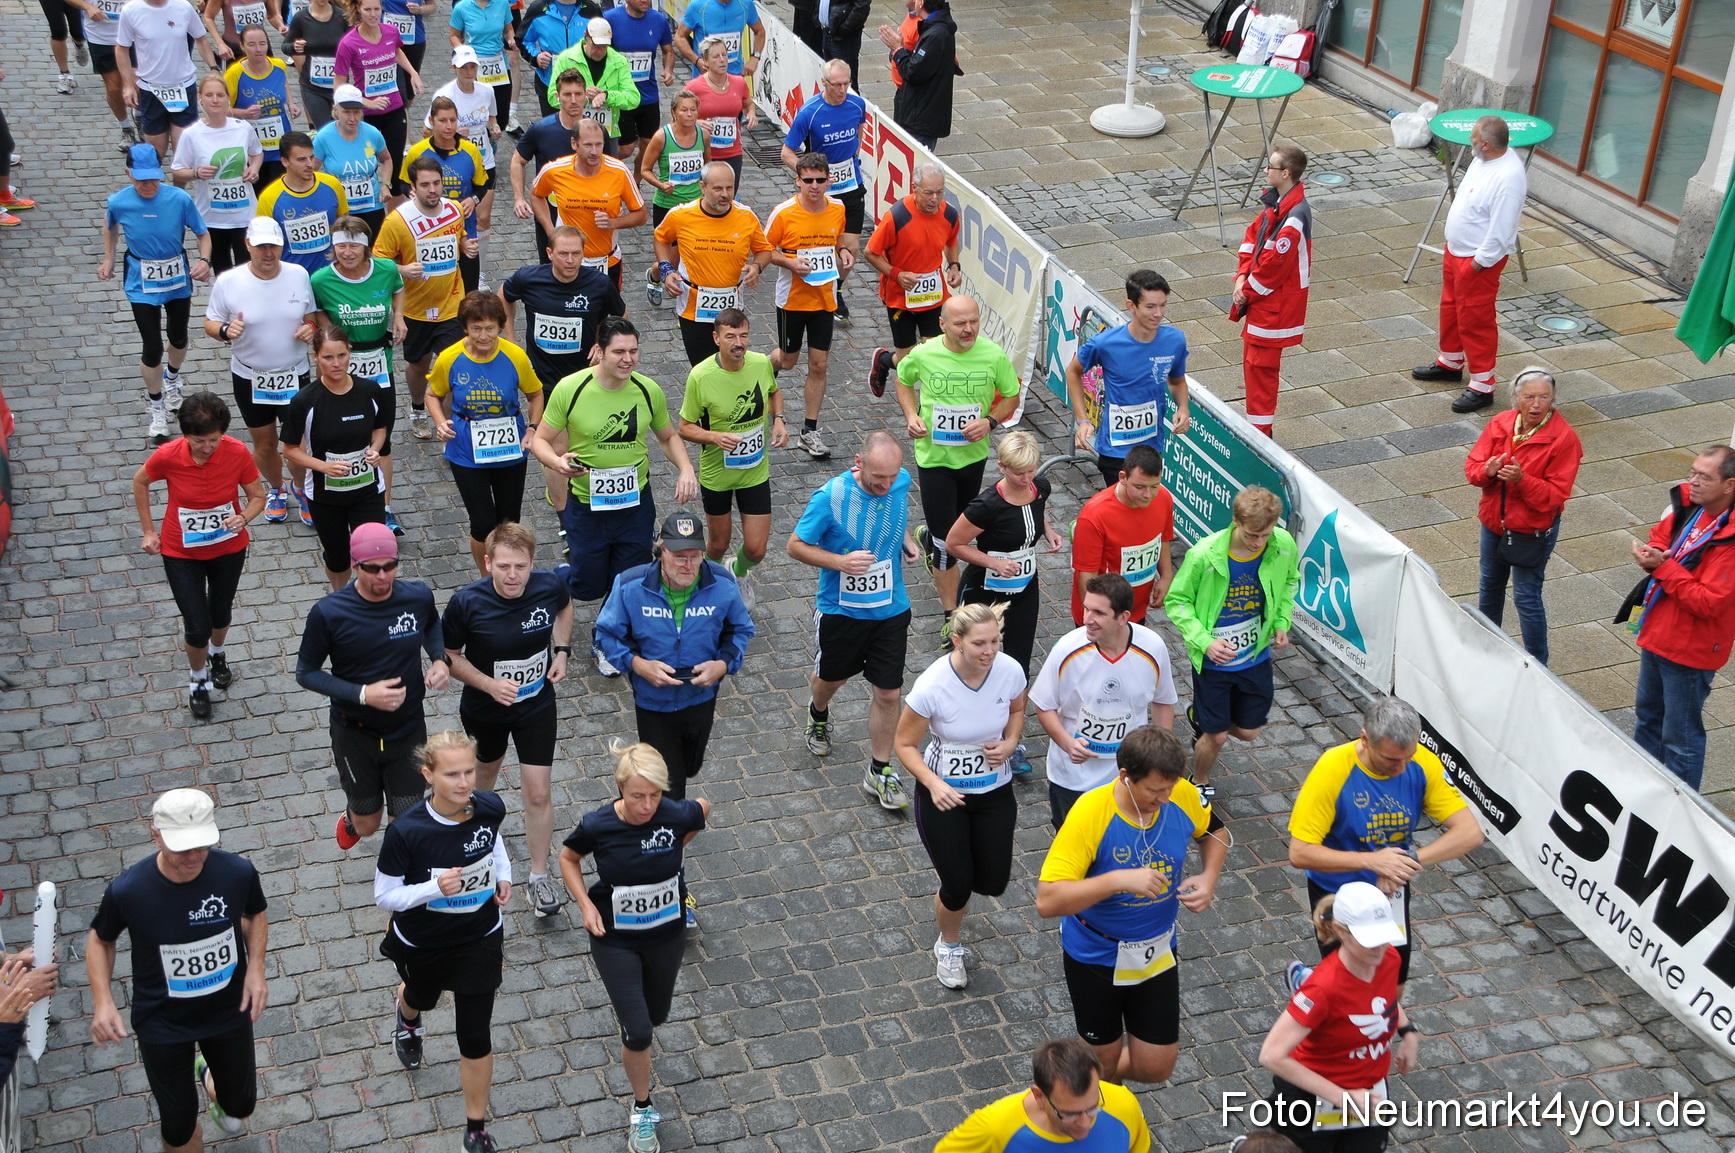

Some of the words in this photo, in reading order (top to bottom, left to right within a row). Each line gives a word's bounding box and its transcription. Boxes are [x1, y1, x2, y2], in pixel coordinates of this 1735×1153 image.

[237, 10, 266, 26] 2633
[482, 62, 502, 76] 278
[369, 71, 394, 86] 2494
[711, 124, 735, 138] 813
[823, 127, 856, 143] SYSCAD
[343, 160, 377, 175] ANY
[673, 159, 703, 174] 2893
[833, 167, 853, 184] 354
[212, 185, 247, 201] 2488
[291, 221, 327, 243] 3385
[421, 244, 455, 263] 2453
[146, 262, 181, 281] 2141
[810, 257, 834, 272] 319
[914, 279, 937, 295] 299
[564, 300, 582, 312] Spitz
[701, 294, 736, 311] 2239
[539, 324, 578, 342] 2934
[547, 341, 568, 351] Harald
[349, 358, 384, 376] 2421
[256, 373, 295, 391] 2422
[929, 371, 988, 396] OPF
[264, 392, 289, 402] Herbert
[725, 398, 744, 423] GOSSEN
[934, 406, 950, 414] PARTL
[950, 407, 974, 415] Neumarkt
[593, 418, 616, 441] GOSSEN
[1114, 411, 1154, 432] 2670
[477, 428, 517, 448] 2723
[729, 433, 764, 456] 2238
[1122, 431, 1148, 441] Samuel
[481, 447, 516, 459] Rosemarie
[597, 442, 638, 451] METRAWATT
[1173, 442, 1232, 510] Sicherheit
[595, 476, 635, 497] 2330
[1175, 472, 1213, 522] Event!
[1173, 509, 1185, 528] ice
[1126, 546, 1160, 573] 2178
[845, 571, 888, 595] 3331
[388, 622, 410, 638] Spitz
[522, 617, 543, 633] Spitz
[1321, 627, 1345, 653] Service
[1345, 646, 1367, 671] GmbH
[495, 663, 516, 672] PARTL
[1098, 714, 1126, 724] Neumarkt
[1080, 717, 1127, 742] 2270
[943, 747, 964, 757] PARTL
[1419, 729, 1441, 757] gen,
[1440, 752, 1458, 774] die
[1457, 766, 1506, 823] verbinden
[958, 780, 986, 790] Sabine
[463, 840, 487, 855] Spitz
[446, 896, 479, 909] Verena
[619, 890, 675, 914] 2840
[188, 908, 216, 923] Spitz
[1537, 840, 1686, 991] stadtwerke
[162, 948, 189, 958] PARTL
[189, 939, 225, 956] Neumarkt
[1143, 945, 1156, 965] 9
[171, 943, 233, 978] 2889
[185, 971, 225, 992] Richard
